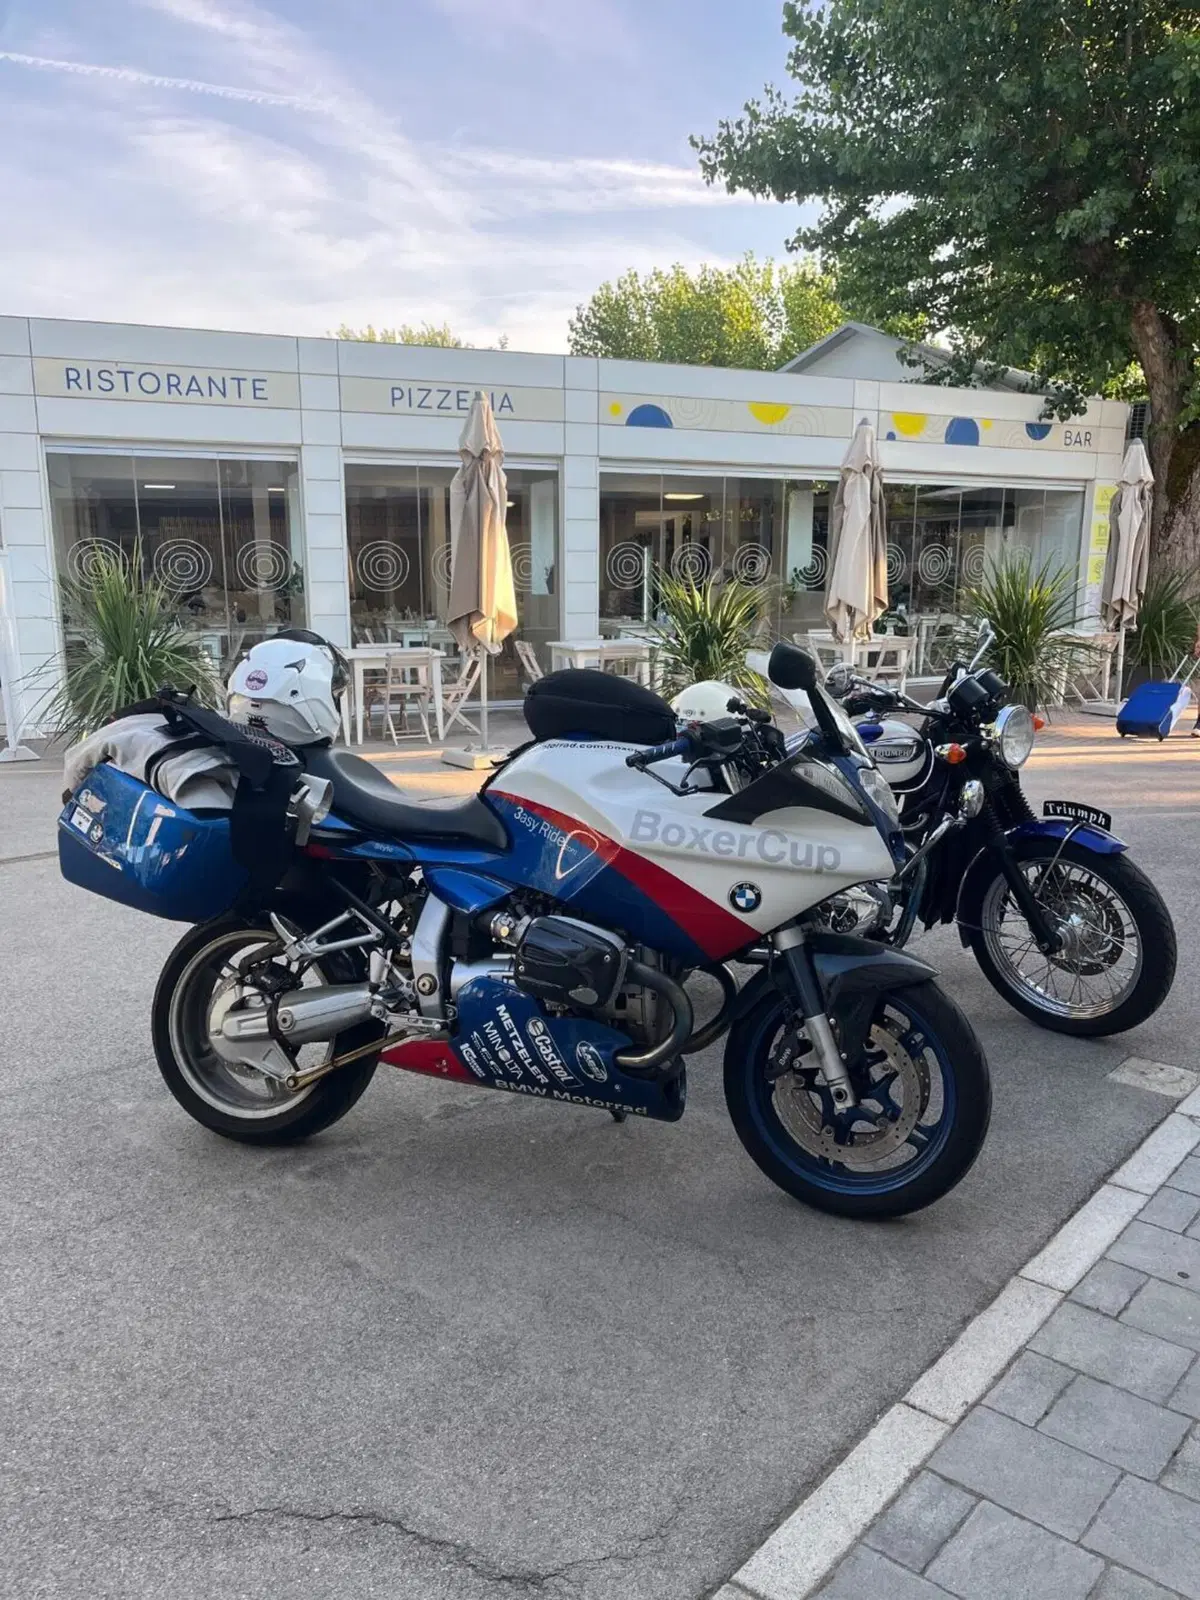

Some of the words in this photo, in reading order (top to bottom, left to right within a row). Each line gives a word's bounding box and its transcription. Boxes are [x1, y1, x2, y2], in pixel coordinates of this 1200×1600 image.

[64, 367, 269, 400] RISTORANTE
[390, 387, 515, 413] PIZZEIA
[1063, 430, 1092, 447] BAR
[870, 749, 910, 758] TRIUMPH
[1046, 802, 1106, 826] Triumph
[629, 809, 841, 875] BoxerCup
[482, 1020, 524, 1080] MINOLTA
[496, 1004, 550, 1084] METZELER
[534, 1035, 575, 1082] Castrol
[494, 1078, 547, 1096] BMW
[552, 1089, 648, 1116] Motorrad
